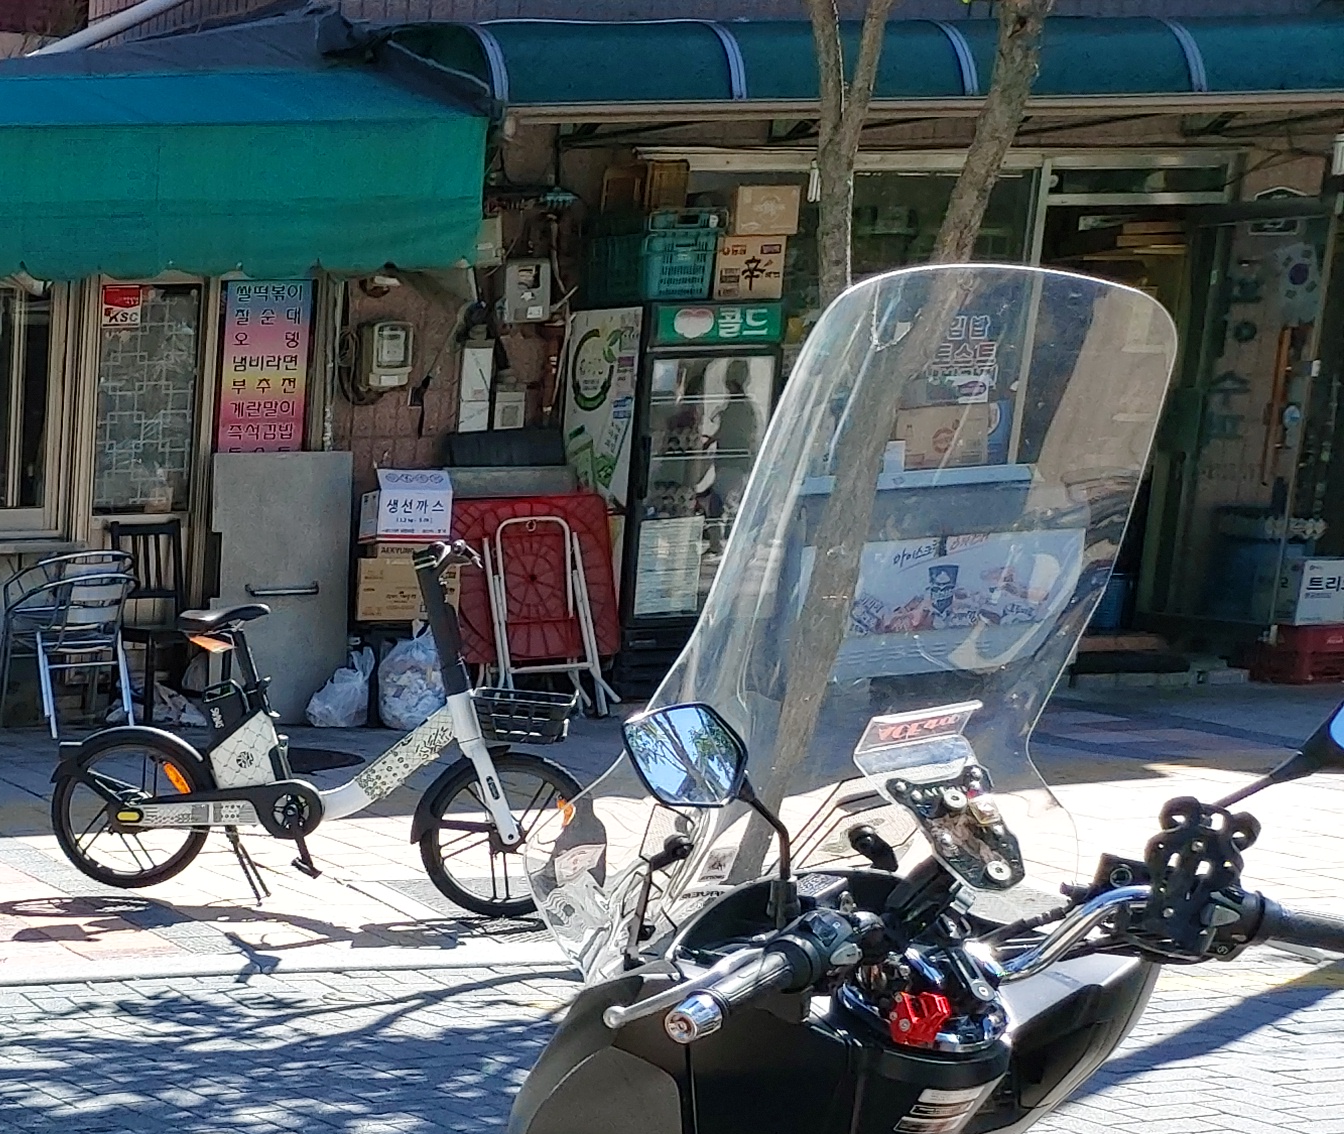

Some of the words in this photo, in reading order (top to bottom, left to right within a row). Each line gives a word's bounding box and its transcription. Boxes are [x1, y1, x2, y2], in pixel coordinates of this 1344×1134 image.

[236, 285, 303, 302] 쌀떡볶이
[718, 307, 768, 338] 콜드
[232, 355, 298, 372] 냄비라면
[231, 377, 297, 394] 부추전
[228, 423, 293, 441] 즉석김밥
[386, 499, 445, 514] 생선까스
[1306, 576, 1344, 592] 트리
